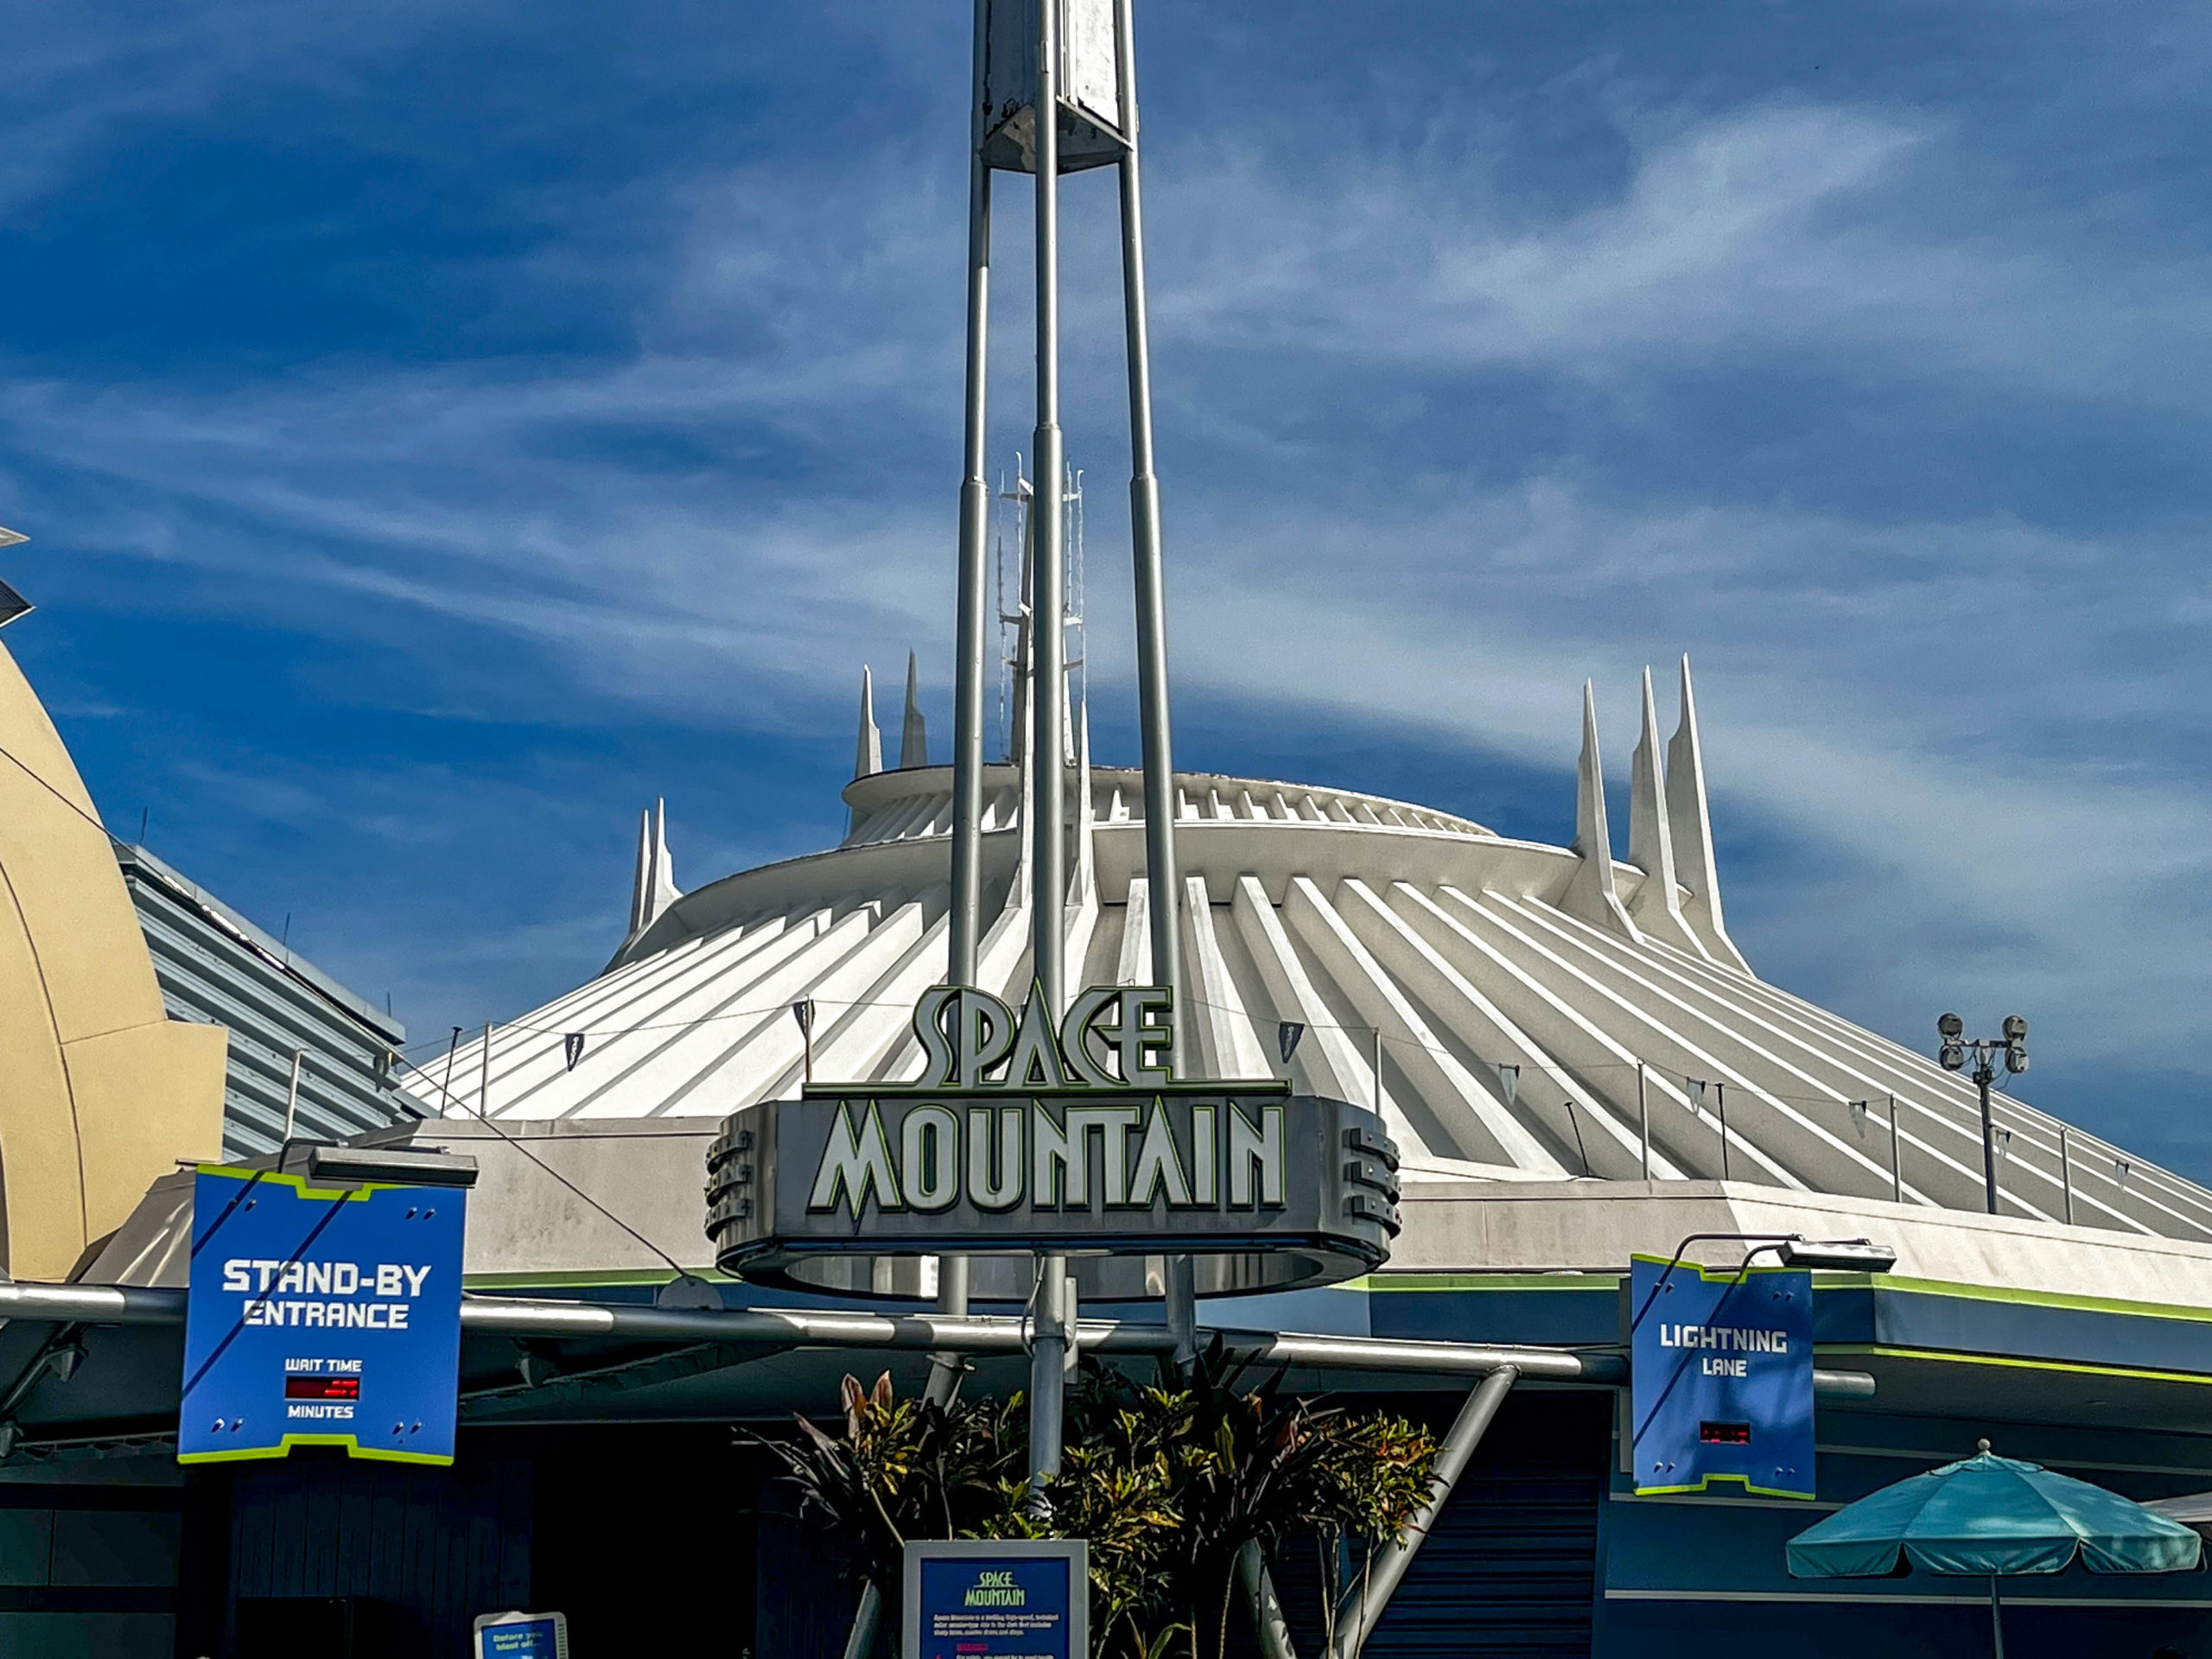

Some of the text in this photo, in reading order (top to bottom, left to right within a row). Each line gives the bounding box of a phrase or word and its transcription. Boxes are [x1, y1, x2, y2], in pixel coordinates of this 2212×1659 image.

[912, 976, 1173, 1085] SPACE
[807, 1095, 1287, 1221] MOUNTAIN
[222, 1257, 432, 1297] STAND-BY
[243, 1300, 410, 1329] ENTRANCE
[1660, 1324, 1788, 1353] LIGHTNING
[284, 1358, 363, 1372] WAIT TIME
[1702, 1357, 1747, 1377] LANE
[287, 1405, 354, 1419] MINUTES
[979, 1571, 1014, 1586] SPACE
[964, 1589, 1025, 1606] MOUNTAIN
